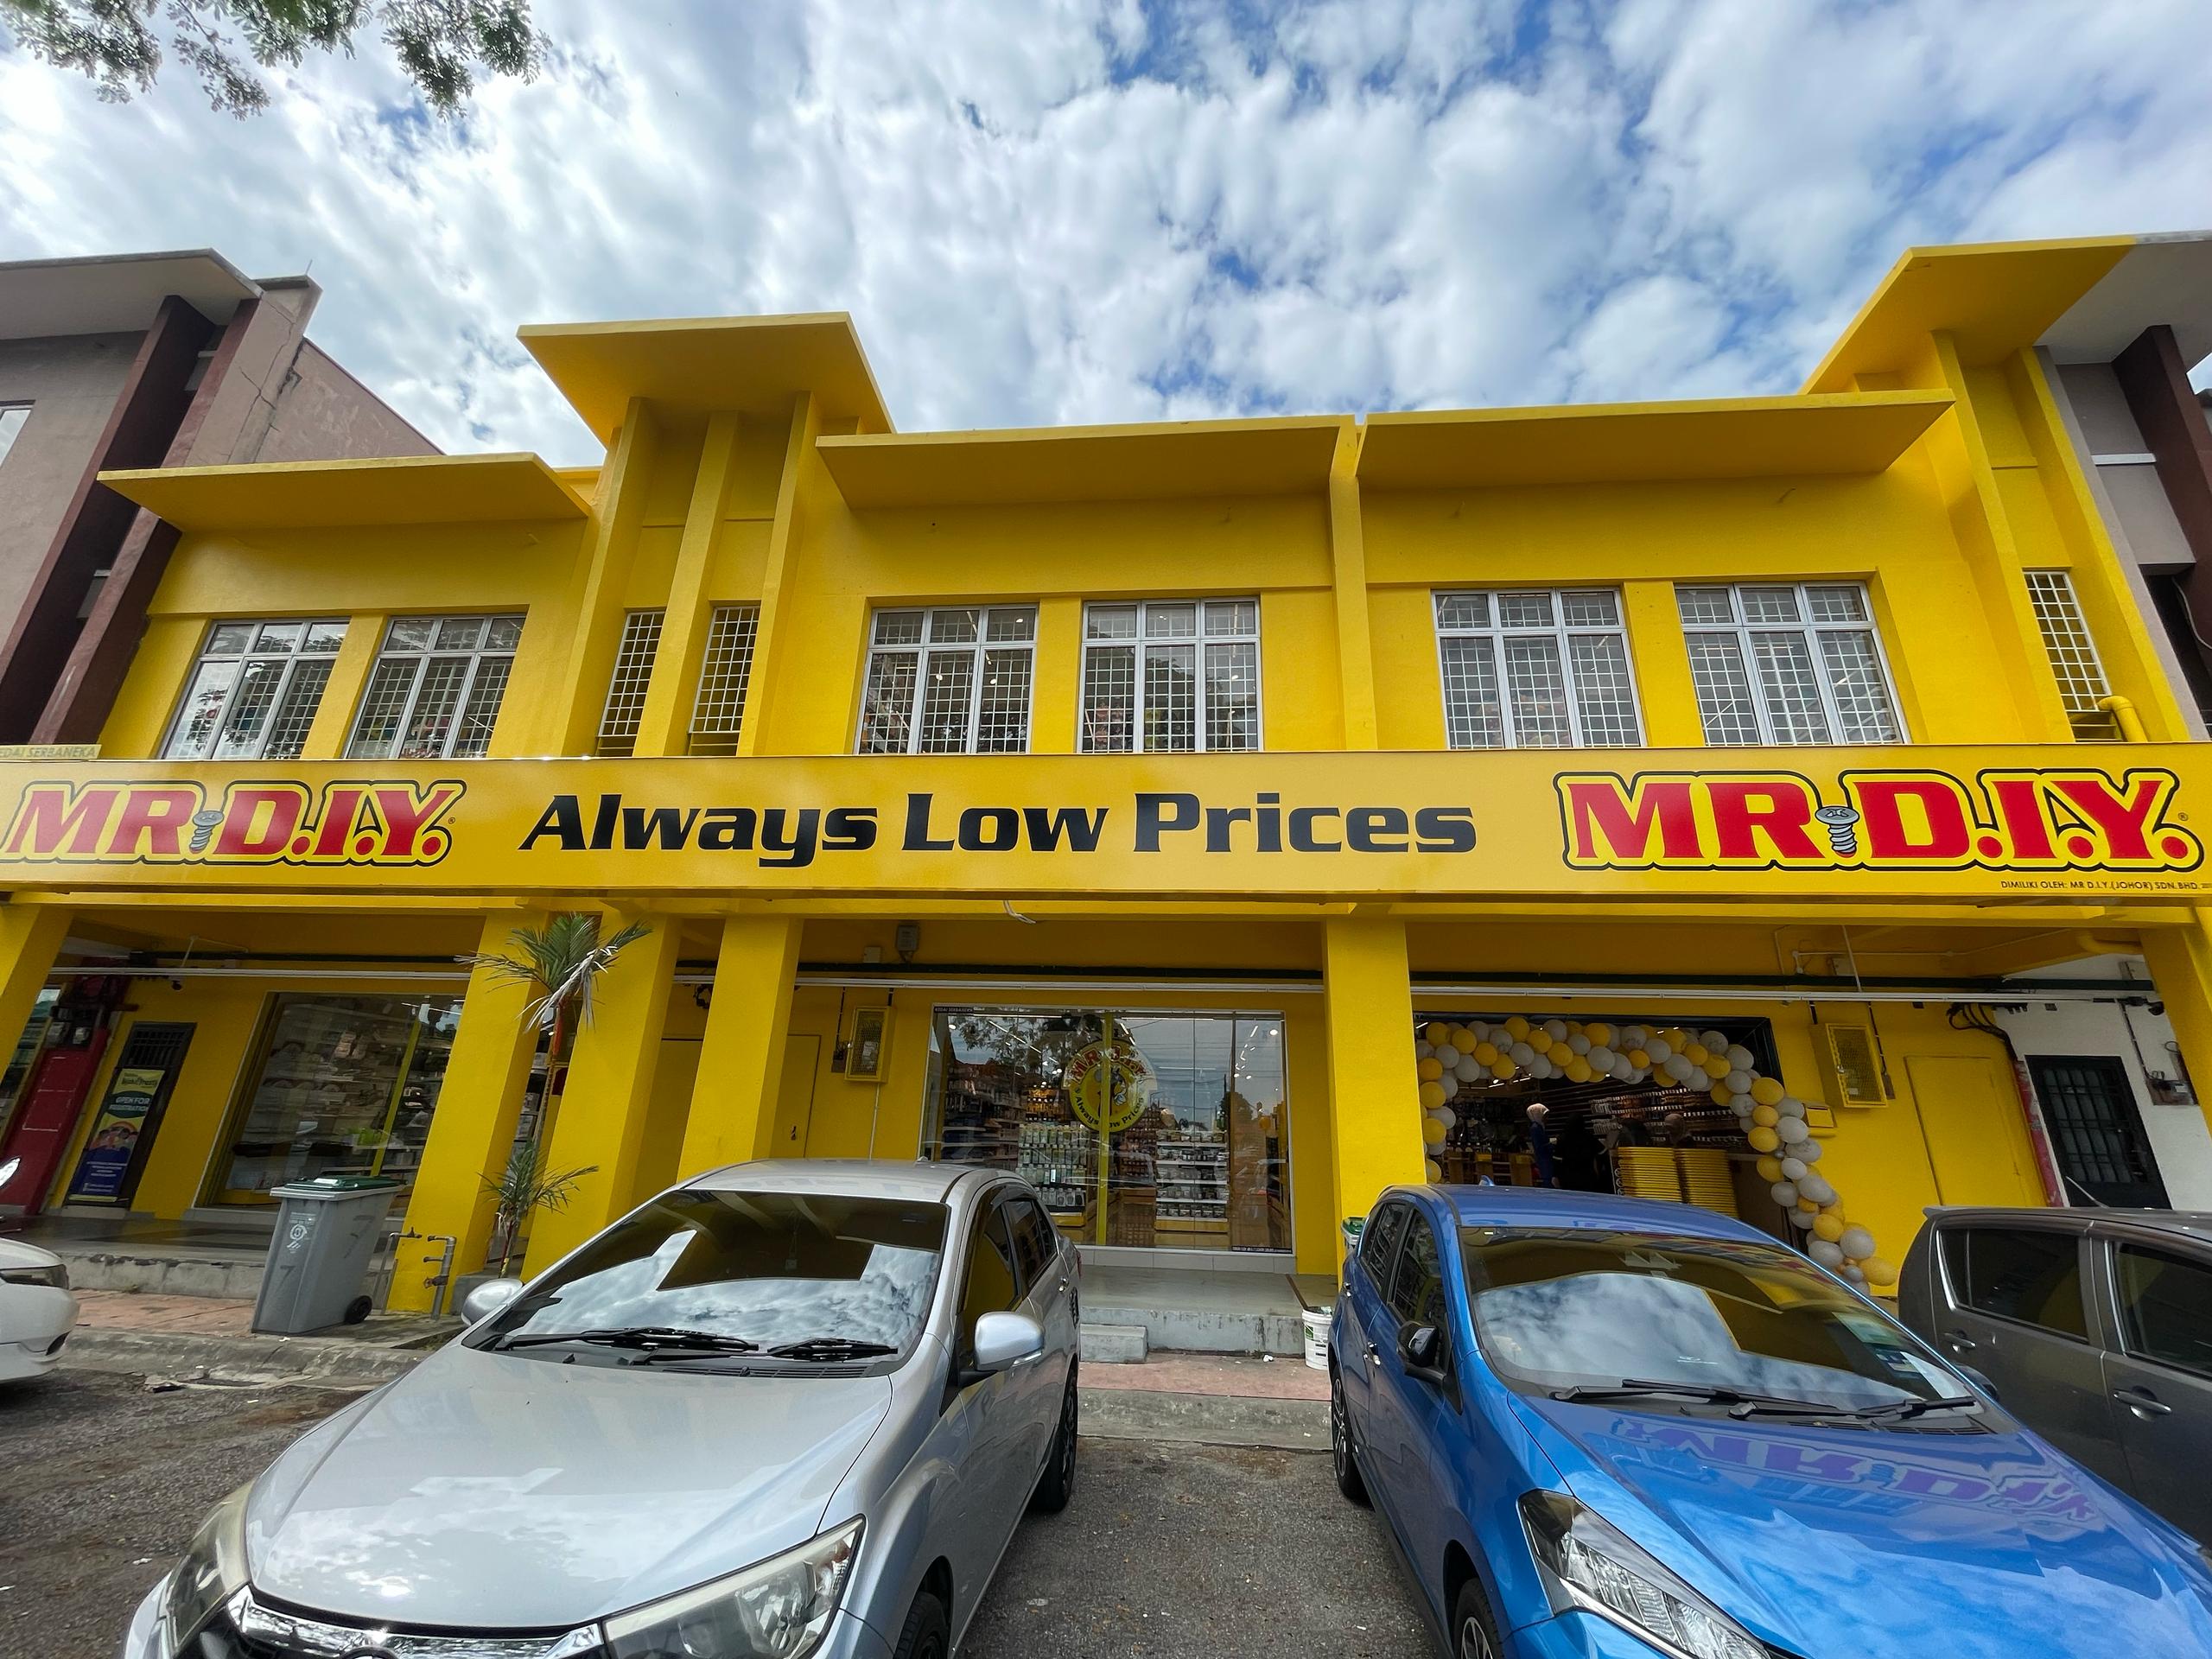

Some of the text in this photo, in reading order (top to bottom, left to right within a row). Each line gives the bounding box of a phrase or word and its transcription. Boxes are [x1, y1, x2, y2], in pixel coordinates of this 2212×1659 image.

[518, 791, 1477, 868] Always Low Prices
[2040, 880, 2068, 889] OLEH:
[2069, 880, 2084, 889] MR
